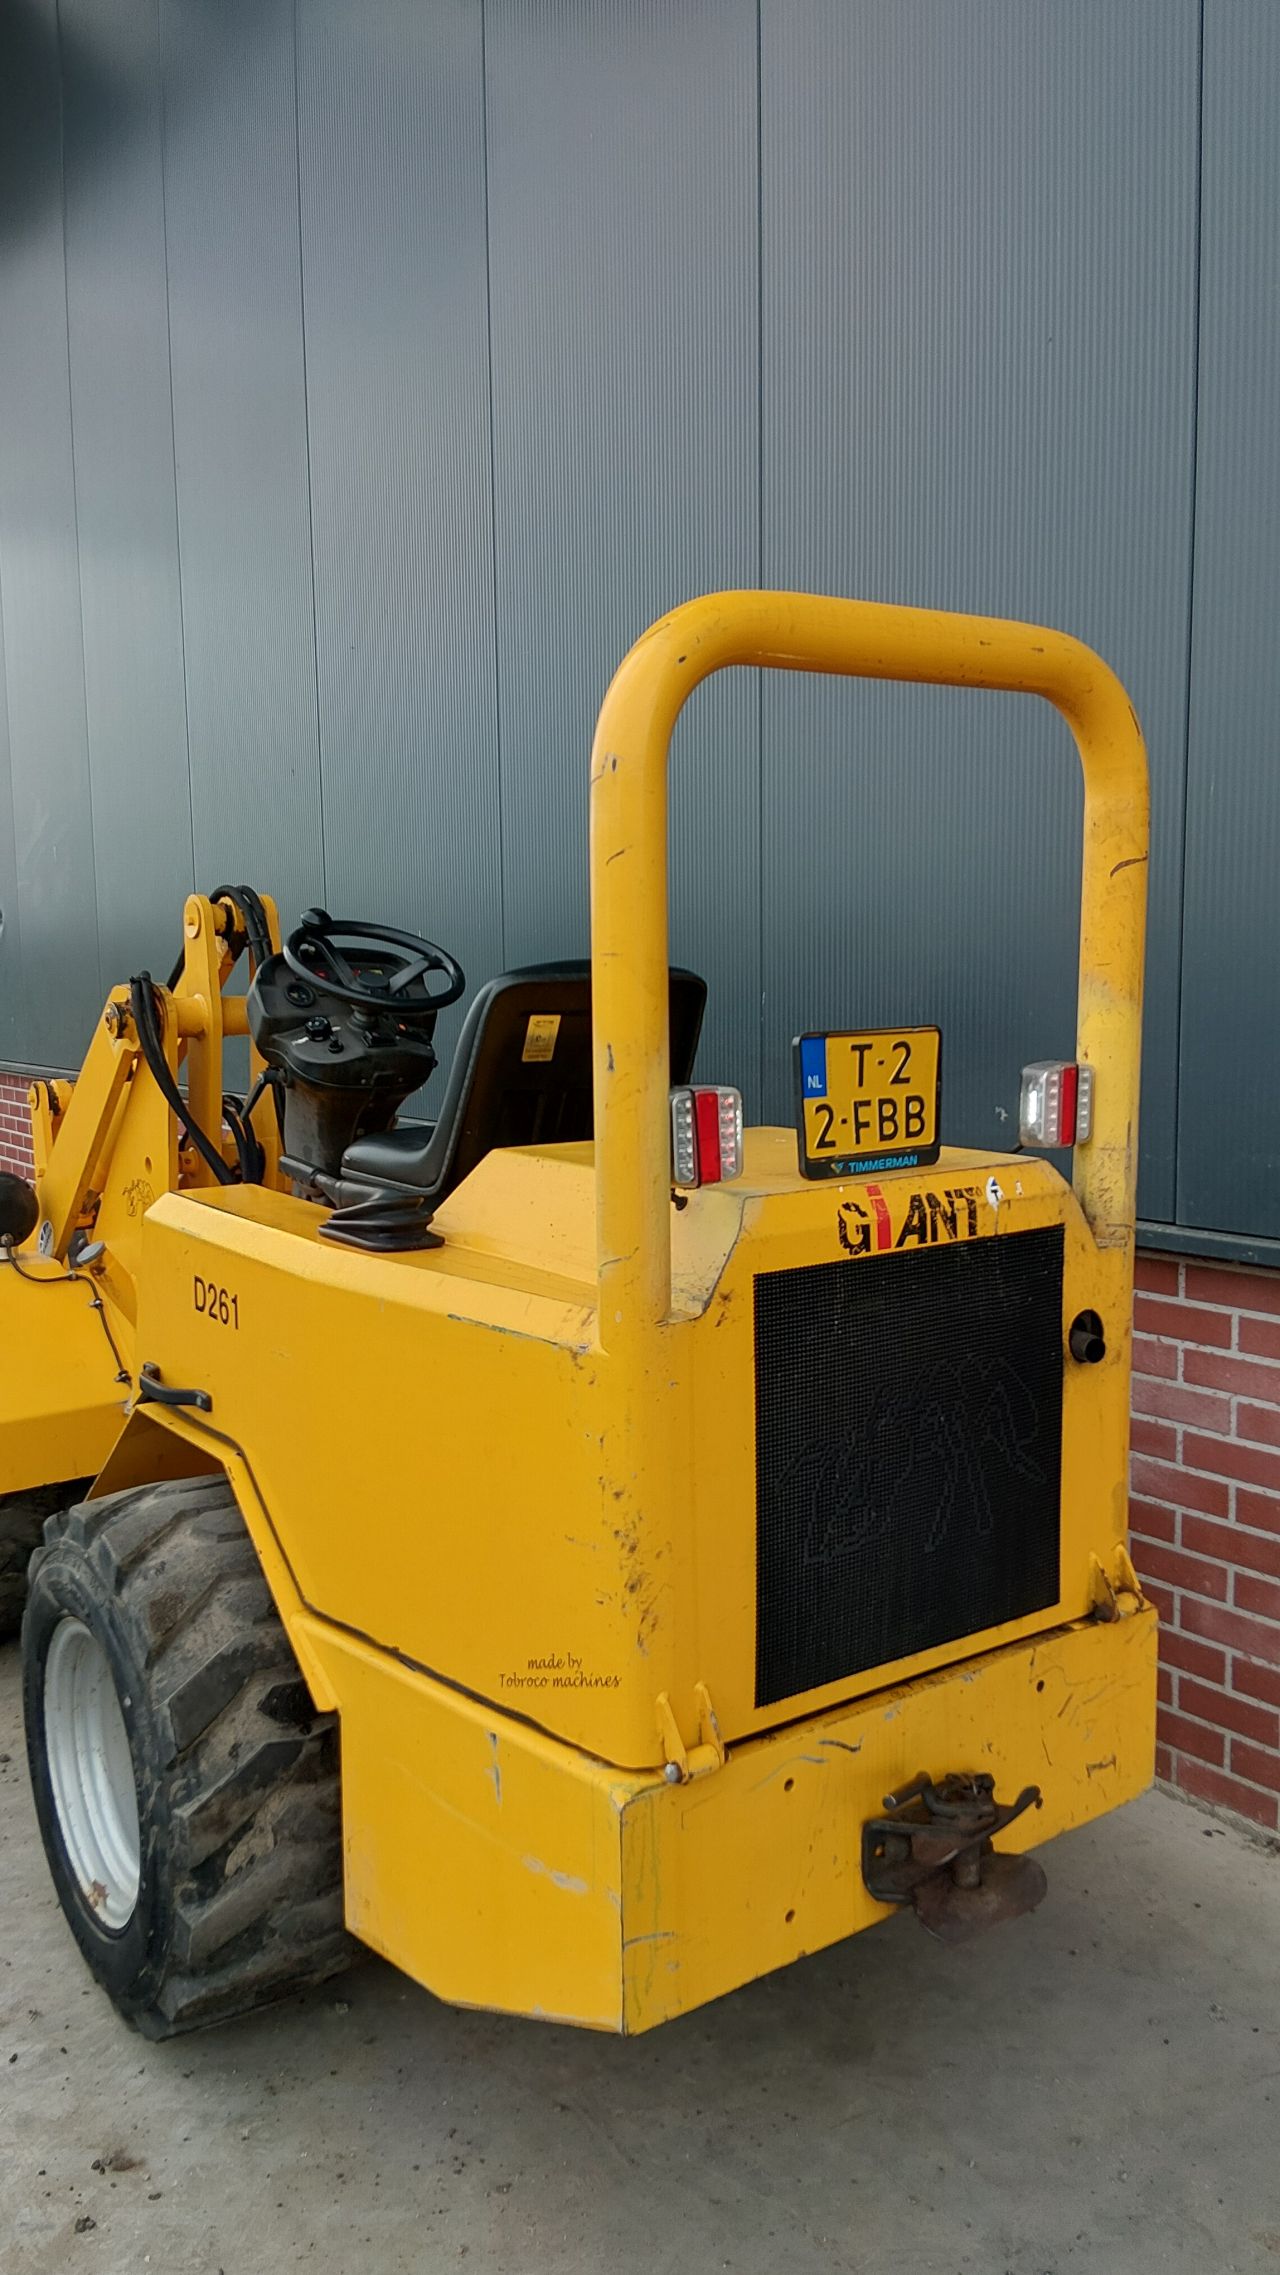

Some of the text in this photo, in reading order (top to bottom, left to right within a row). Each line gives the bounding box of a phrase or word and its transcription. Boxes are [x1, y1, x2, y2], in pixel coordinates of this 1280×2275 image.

[807, 1074, 823, 1089] NL
[814, 1095, 926, 1150] 2-FBB
[848, 1155, 918, 1173] TIMMERMAN
[194, 1275, 239, 1330] D261
[527, 1652, 583, 1672] made by
[499, 1670, 622, 1688] Tobroco machines
